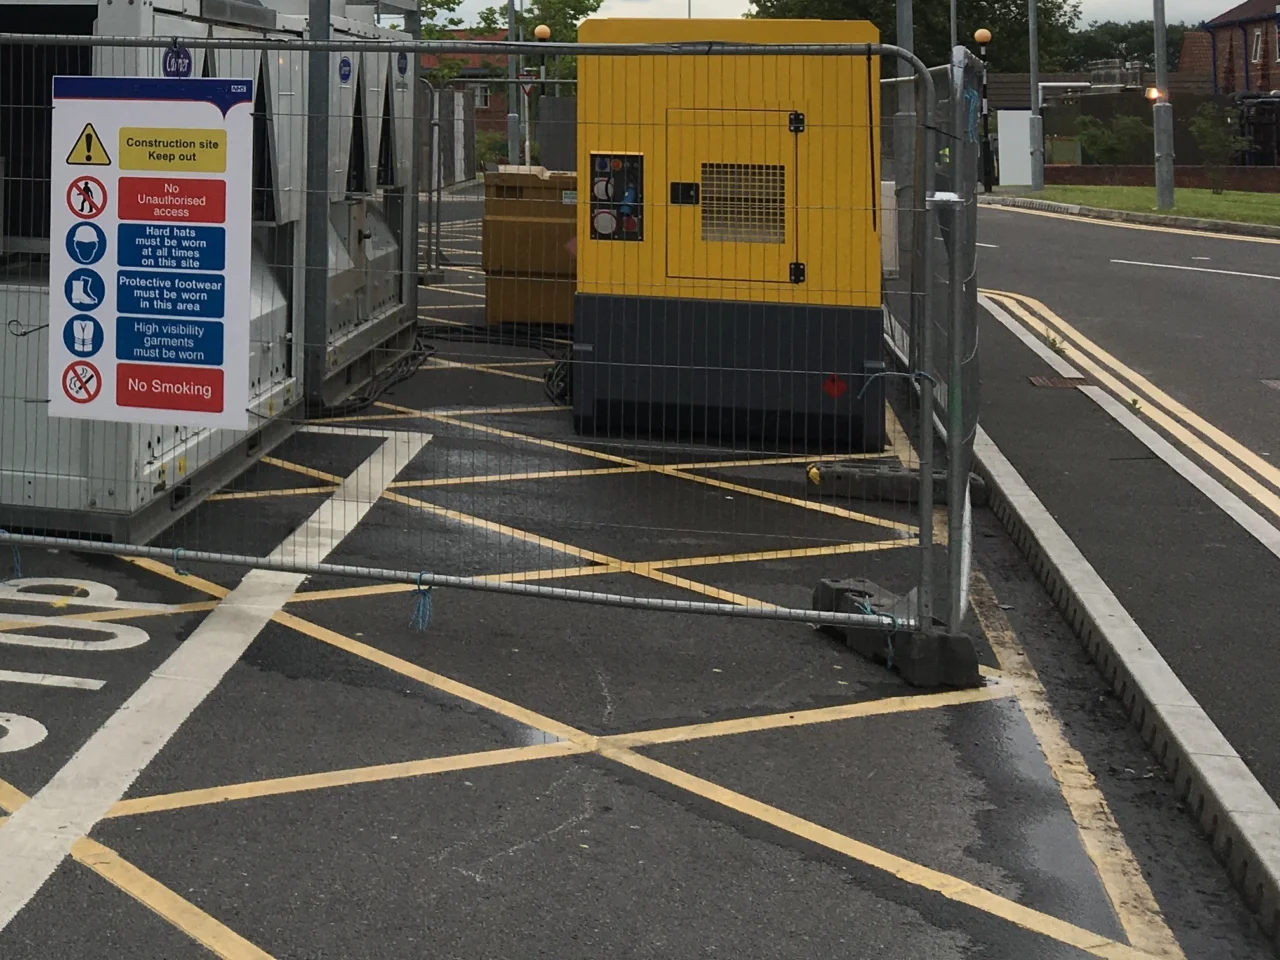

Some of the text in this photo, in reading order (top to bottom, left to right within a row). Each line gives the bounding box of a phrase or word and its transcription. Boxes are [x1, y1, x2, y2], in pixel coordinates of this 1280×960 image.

[126, 137, 219, 150] Construction site
[148, 150, 197, 163] Keep out
[164, 183, 179, 194] No
[137, 194, 206, 206] Unauthorised
[153, 207, 189, 217] access
[146, 226, 196, 237] Hard hats
[136, 236, 207, 248] must be worn
[142, 248, 200, 258] at all times
[141, 257, 200, 268] on this site
[119, 276, 222, 290] Protective footwear
[134, 289, 208, 301] must be worn
[140, 299, 200, 312] in this area
[134, 322, 204, 339] High visibility
[144, 336, 194, 349] garments
[134, 347, 204, 360] must be worn
[128, 379, 212, 399] No Smoking
